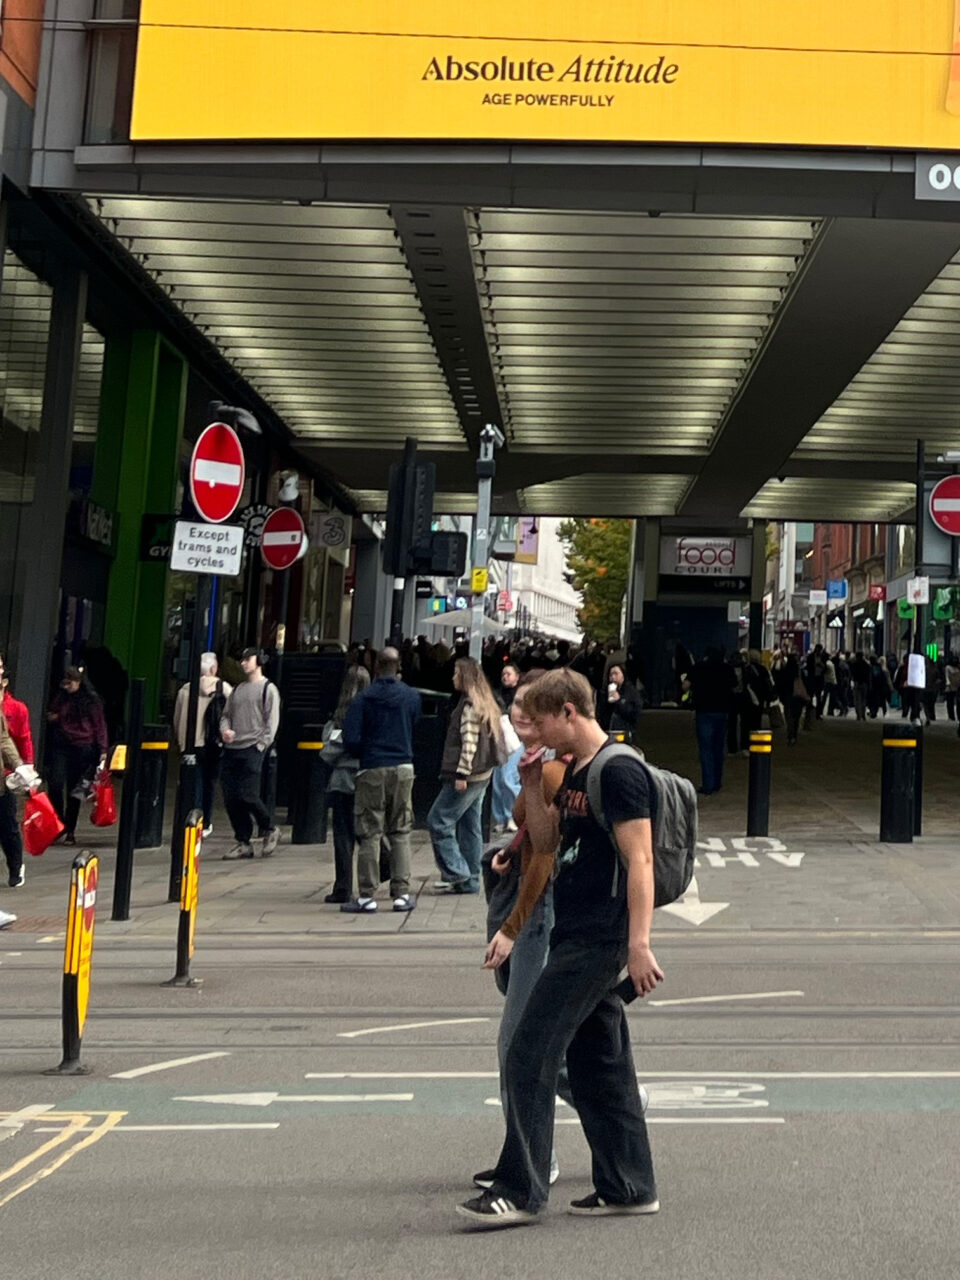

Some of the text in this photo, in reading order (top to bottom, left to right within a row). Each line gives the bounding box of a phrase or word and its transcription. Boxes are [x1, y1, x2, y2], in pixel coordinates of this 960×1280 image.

[421, 54, 680, 84] Absolute Attitude
[482, 93, 615, 108] AGE POWERFULLY
[188, 527, 230, 542] Except
[322, 516, 346, 547] 3
[178, 540, 238, 556] trams and
[675, 537, 737, 566] food
[187, 556, 225, 568] cycles
[674, 565, 734, 575] COURT
